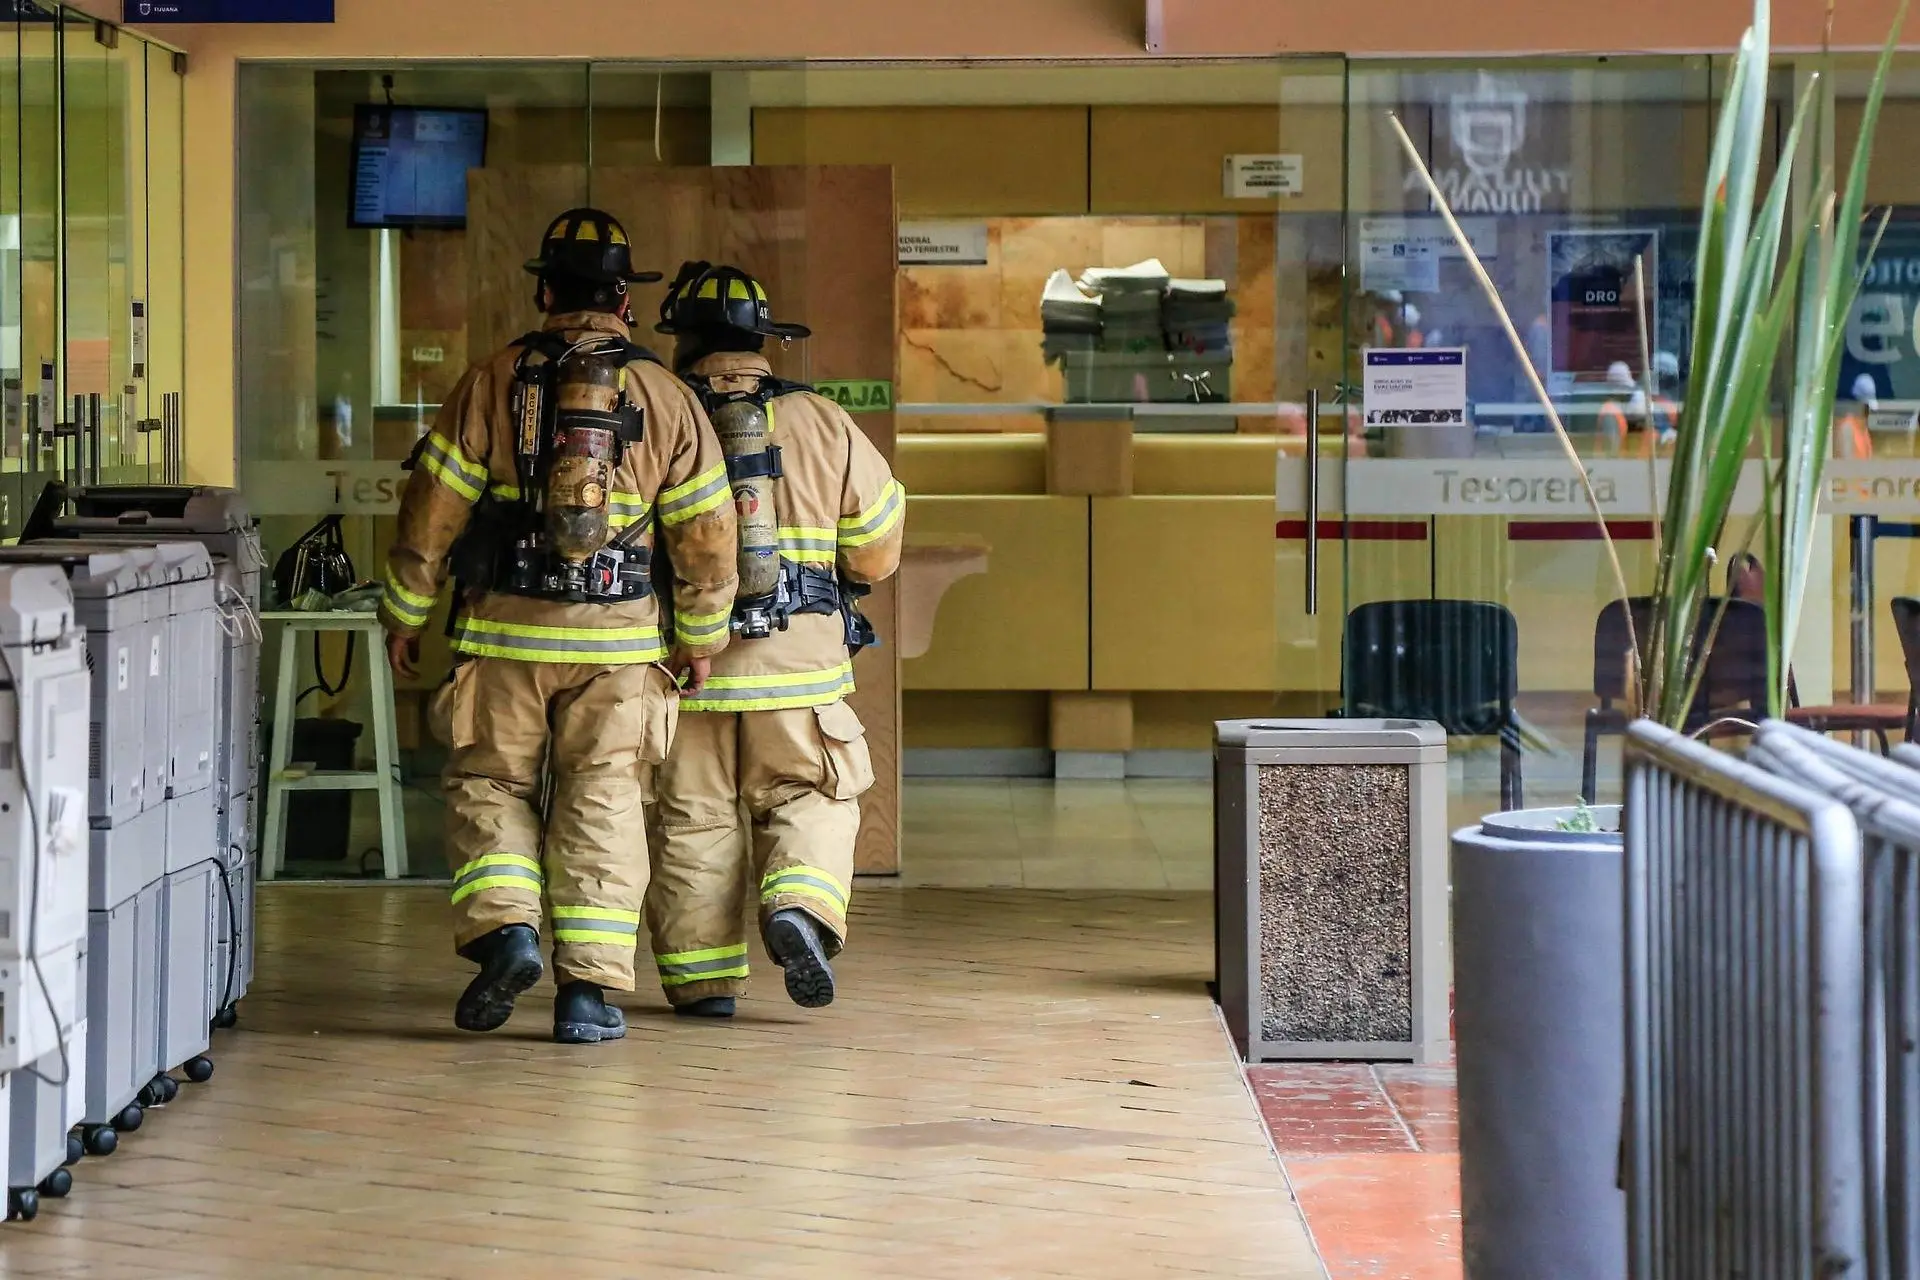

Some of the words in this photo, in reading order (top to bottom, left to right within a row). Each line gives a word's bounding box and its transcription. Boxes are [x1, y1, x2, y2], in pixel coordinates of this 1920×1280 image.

[914, 244, 960, 254] TERRESTRE
[1585, 289, 1617, 303] DRO
[817, 385, 889, 407] CAJA
[526, 392, 537, 432] SCOTT
[1433, 467, 1617, 504] Tesorería
